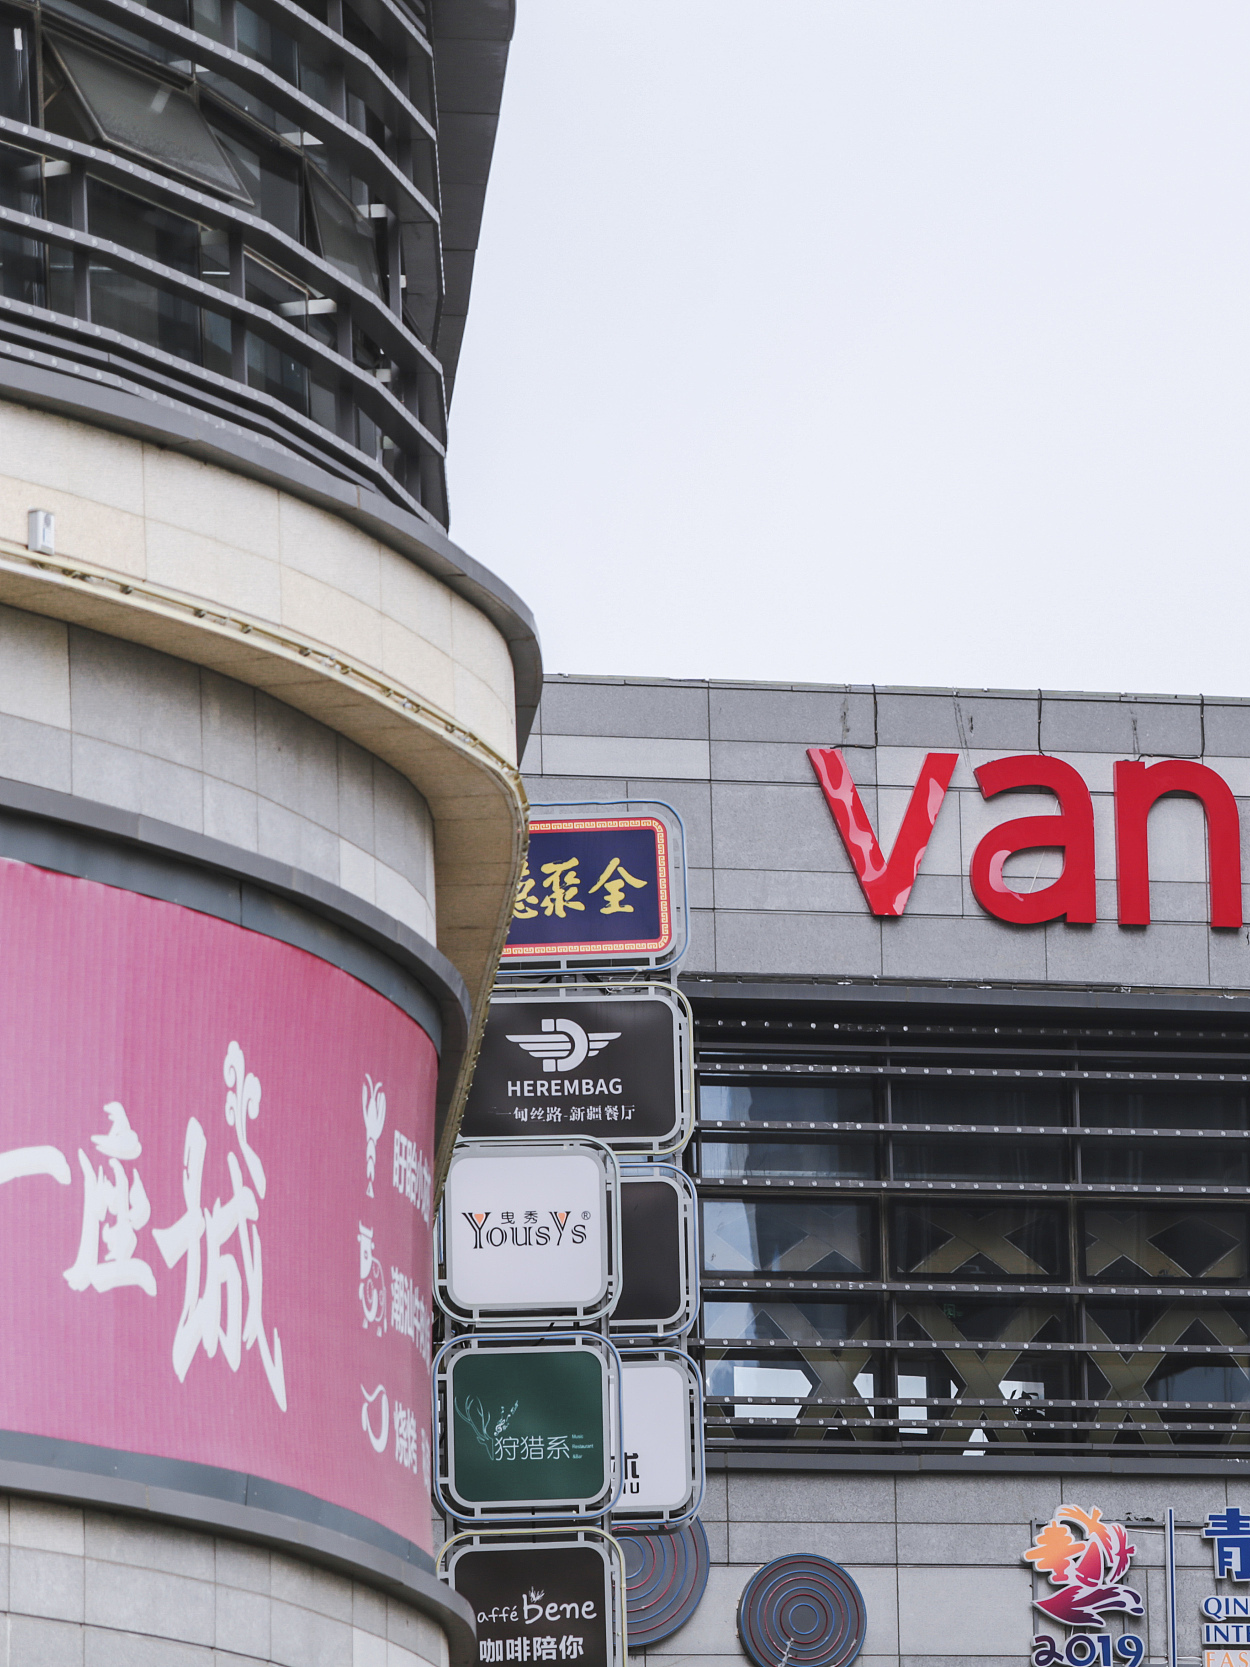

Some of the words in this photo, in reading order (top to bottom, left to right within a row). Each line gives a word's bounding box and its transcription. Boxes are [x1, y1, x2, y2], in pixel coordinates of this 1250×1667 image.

[507, 1078, 623, 1097] HEREMBAG
[494, 1435, 570, 1461] 狩猎系
[522, 1594, 597, 1625] bene
[479, 1635, 584, 1663] 咖啡陪你
[1034, 1634, 1144, 1667] 2019
